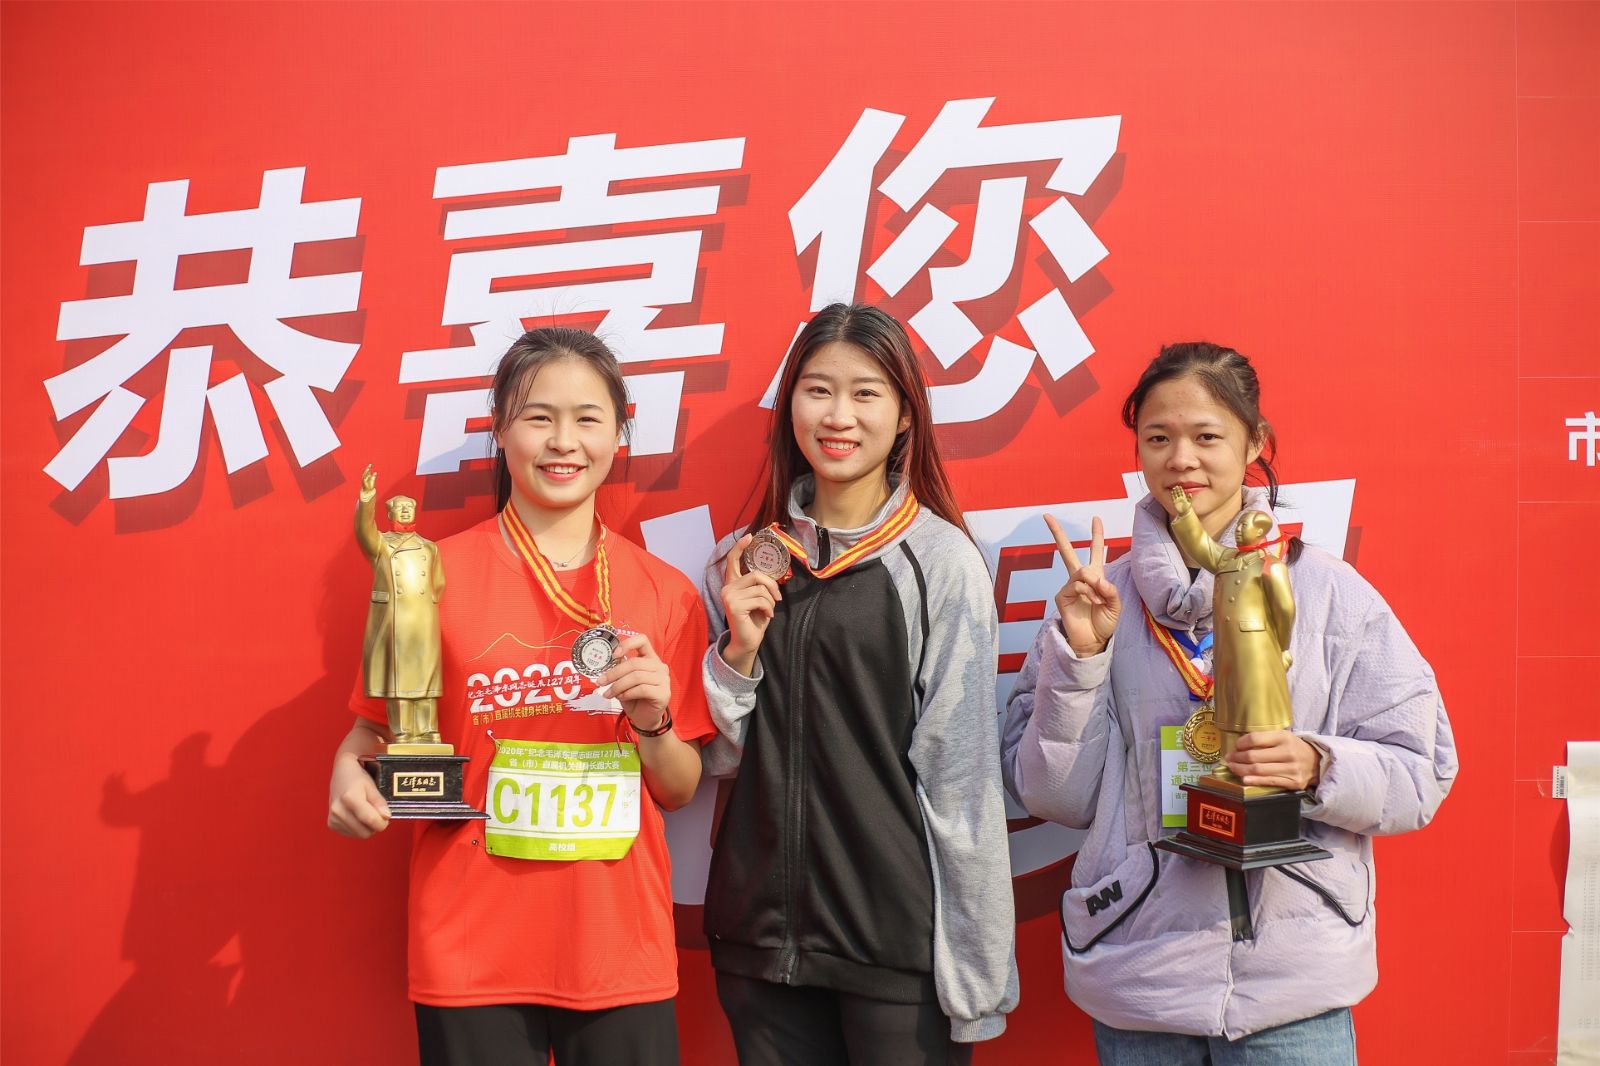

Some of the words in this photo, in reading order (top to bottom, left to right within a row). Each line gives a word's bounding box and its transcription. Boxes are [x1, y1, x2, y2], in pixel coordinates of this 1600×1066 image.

[44, 96, 1122, 500] 恭喜您
[467, 660, 581, 714] 2020
[492, 777, 617, 828] C1137
[1085, 880, 1123, 917] AN
